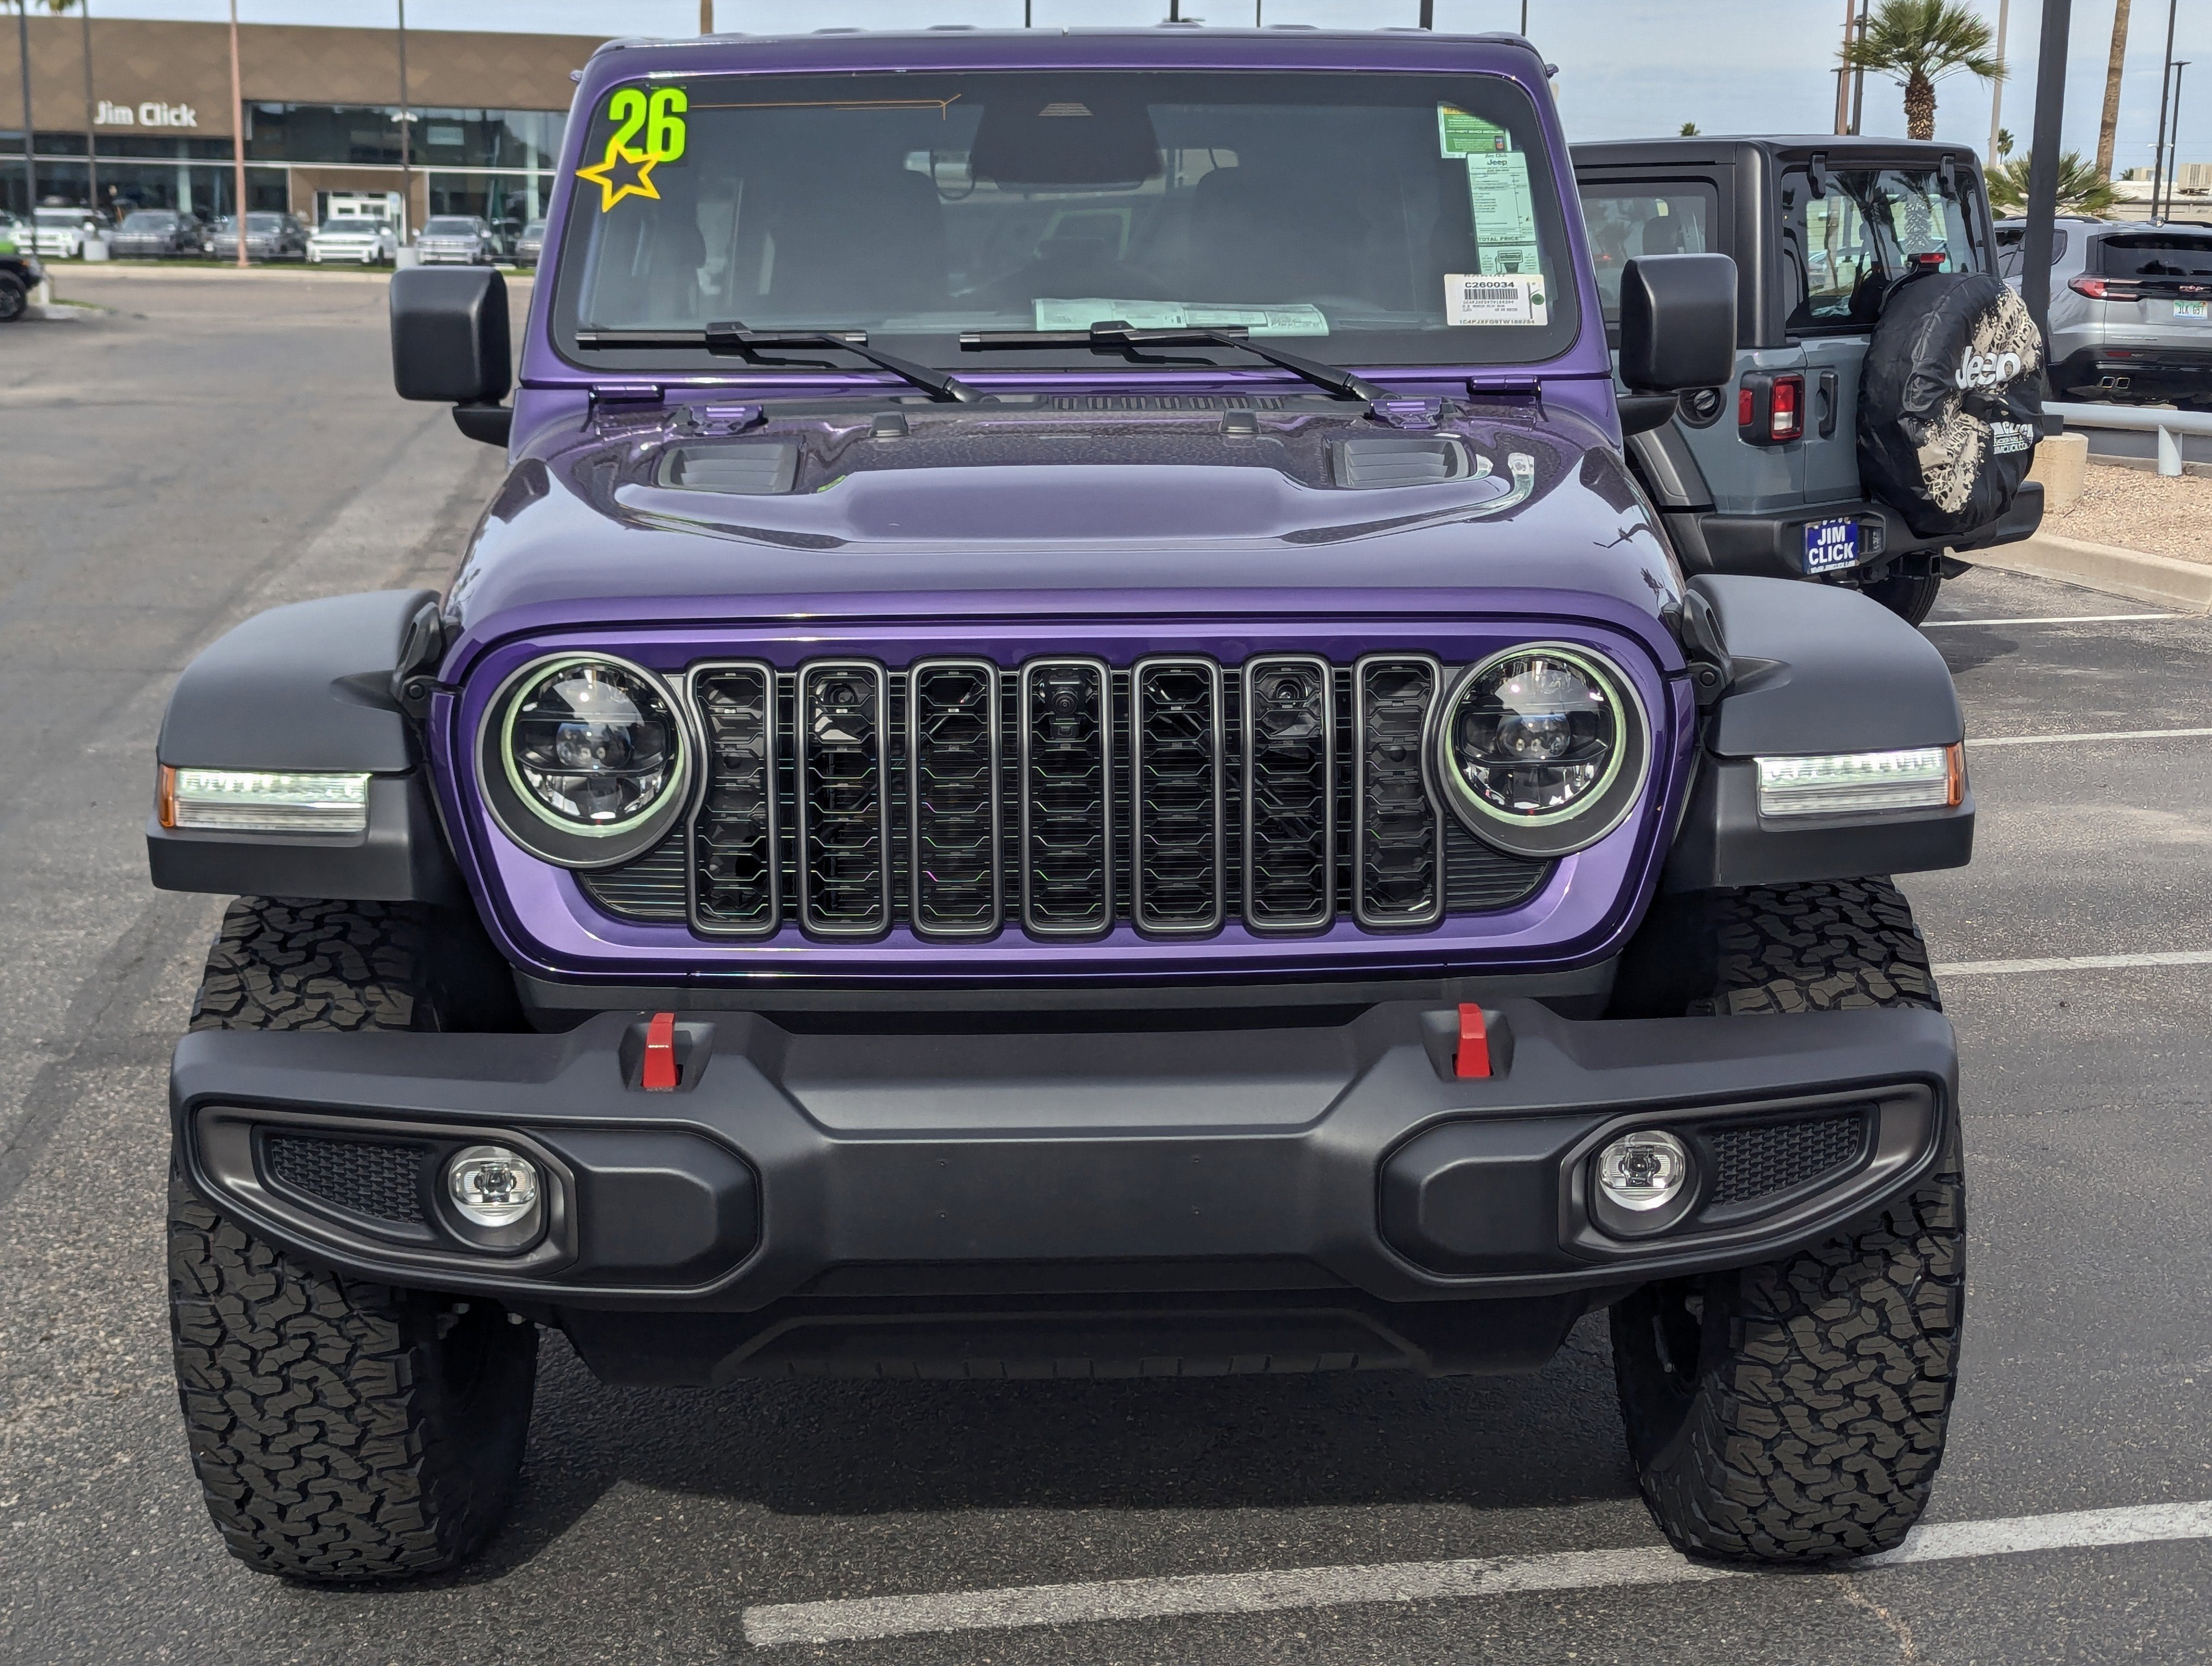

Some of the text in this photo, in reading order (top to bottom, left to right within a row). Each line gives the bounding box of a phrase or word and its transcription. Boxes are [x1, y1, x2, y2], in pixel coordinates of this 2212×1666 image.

[93, 100, 198, 127] Jim Click
[605, 88, 688, 163] 26
[1955, 345, 2021, 390] Jeep
[1817, 526, 1846, 546] JIM
[1809, 542, 1854, 565] CLICK
